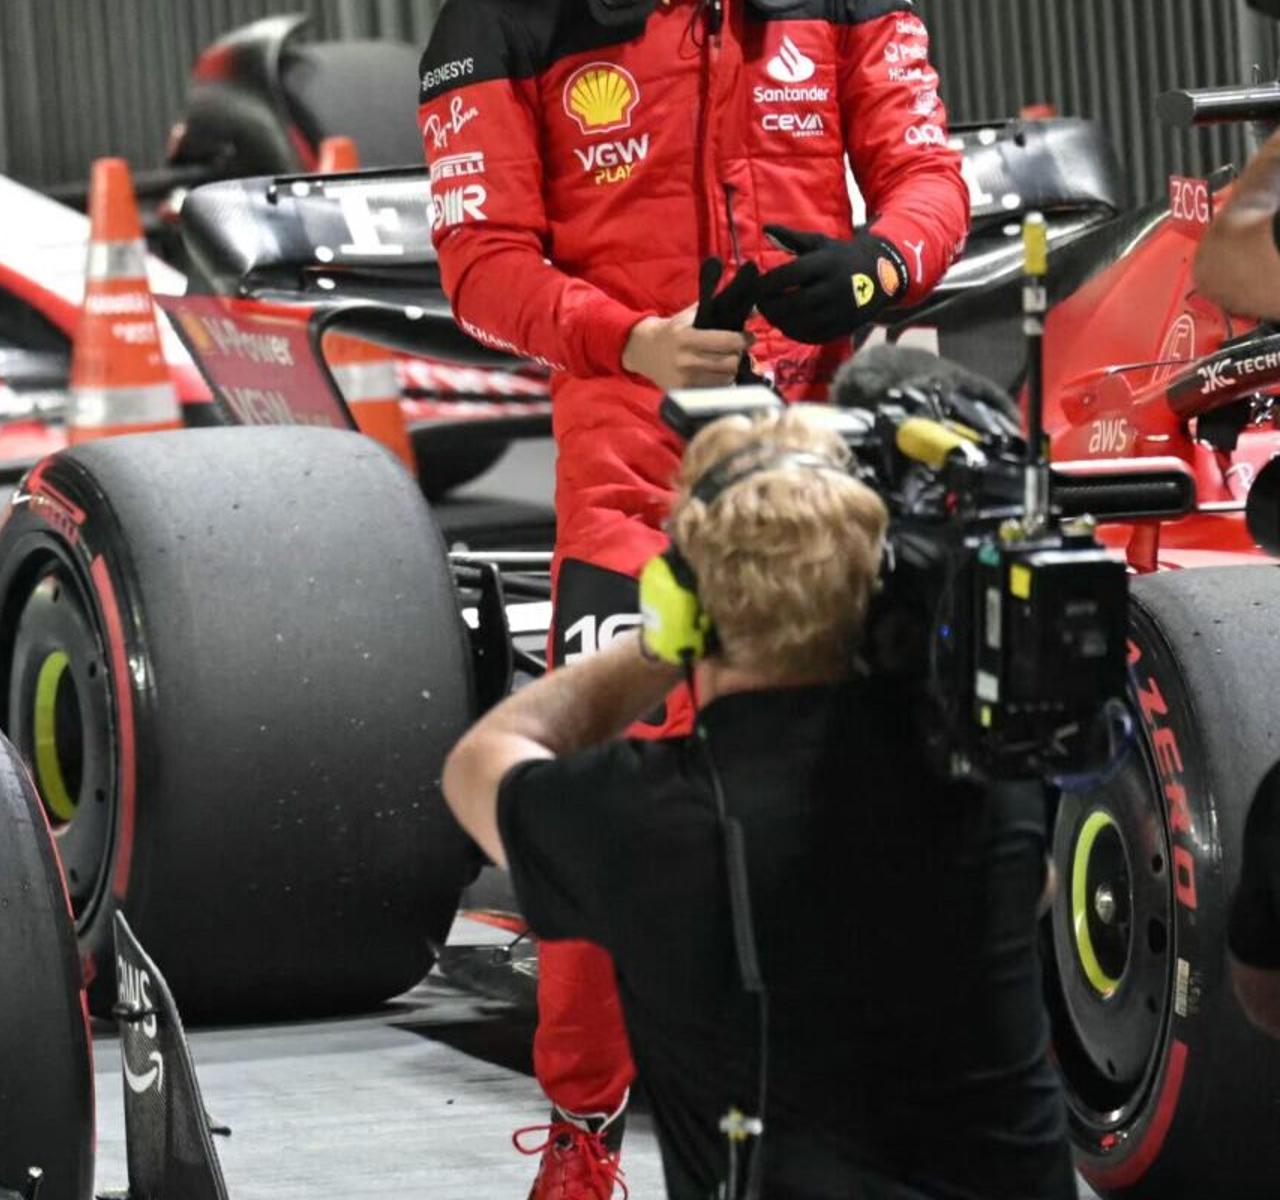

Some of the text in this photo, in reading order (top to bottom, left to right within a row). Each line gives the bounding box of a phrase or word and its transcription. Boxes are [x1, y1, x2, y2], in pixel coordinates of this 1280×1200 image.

[753, 84, 830, 103] Santander
[574, 133, 649, 171] VGW
[595, 163, 634, 184] PLAY
[1088, 418, 1129, 455] aws
